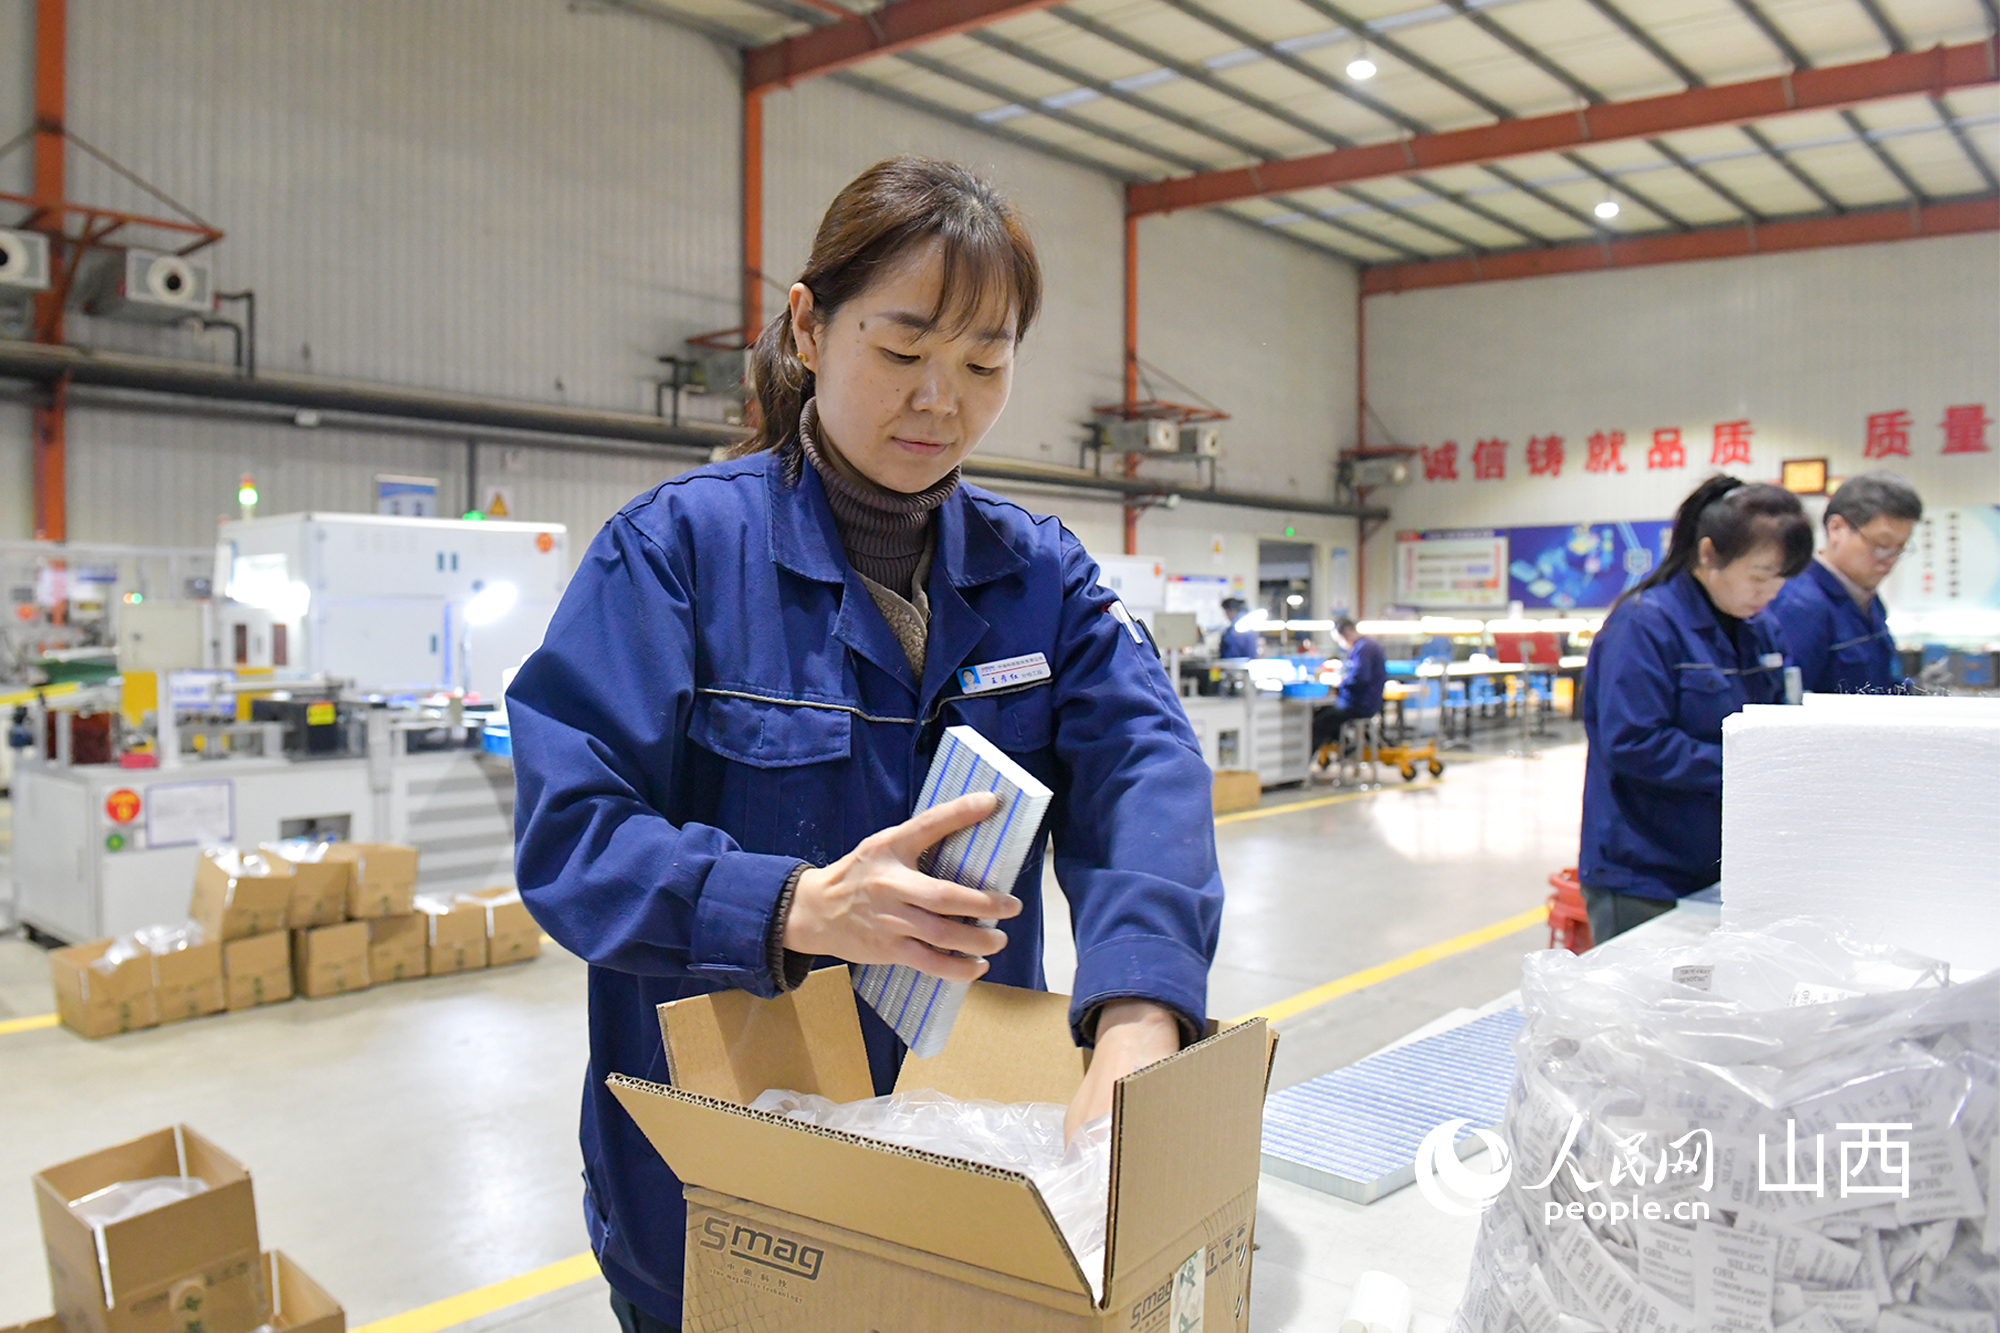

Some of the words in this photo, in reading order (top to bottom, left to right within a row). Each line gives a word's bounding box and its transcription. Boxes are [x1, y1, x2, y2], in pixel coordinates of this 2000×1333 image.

[1863, 403, 1993, 458] 质量
[1420, 420, 1754, 481] 诚信铸就品质
[1643, 1247, 1665, 1261] GEL
[1656, 1239, 1693, 1258] SILICA
[727, 1262, 787, 1289] 中磁科技
[1712, 1266, 1737, 1281] GEL
[1727, 1258, 1768, 1277] SILICA
[762, 1284, 803, 1305] technology
